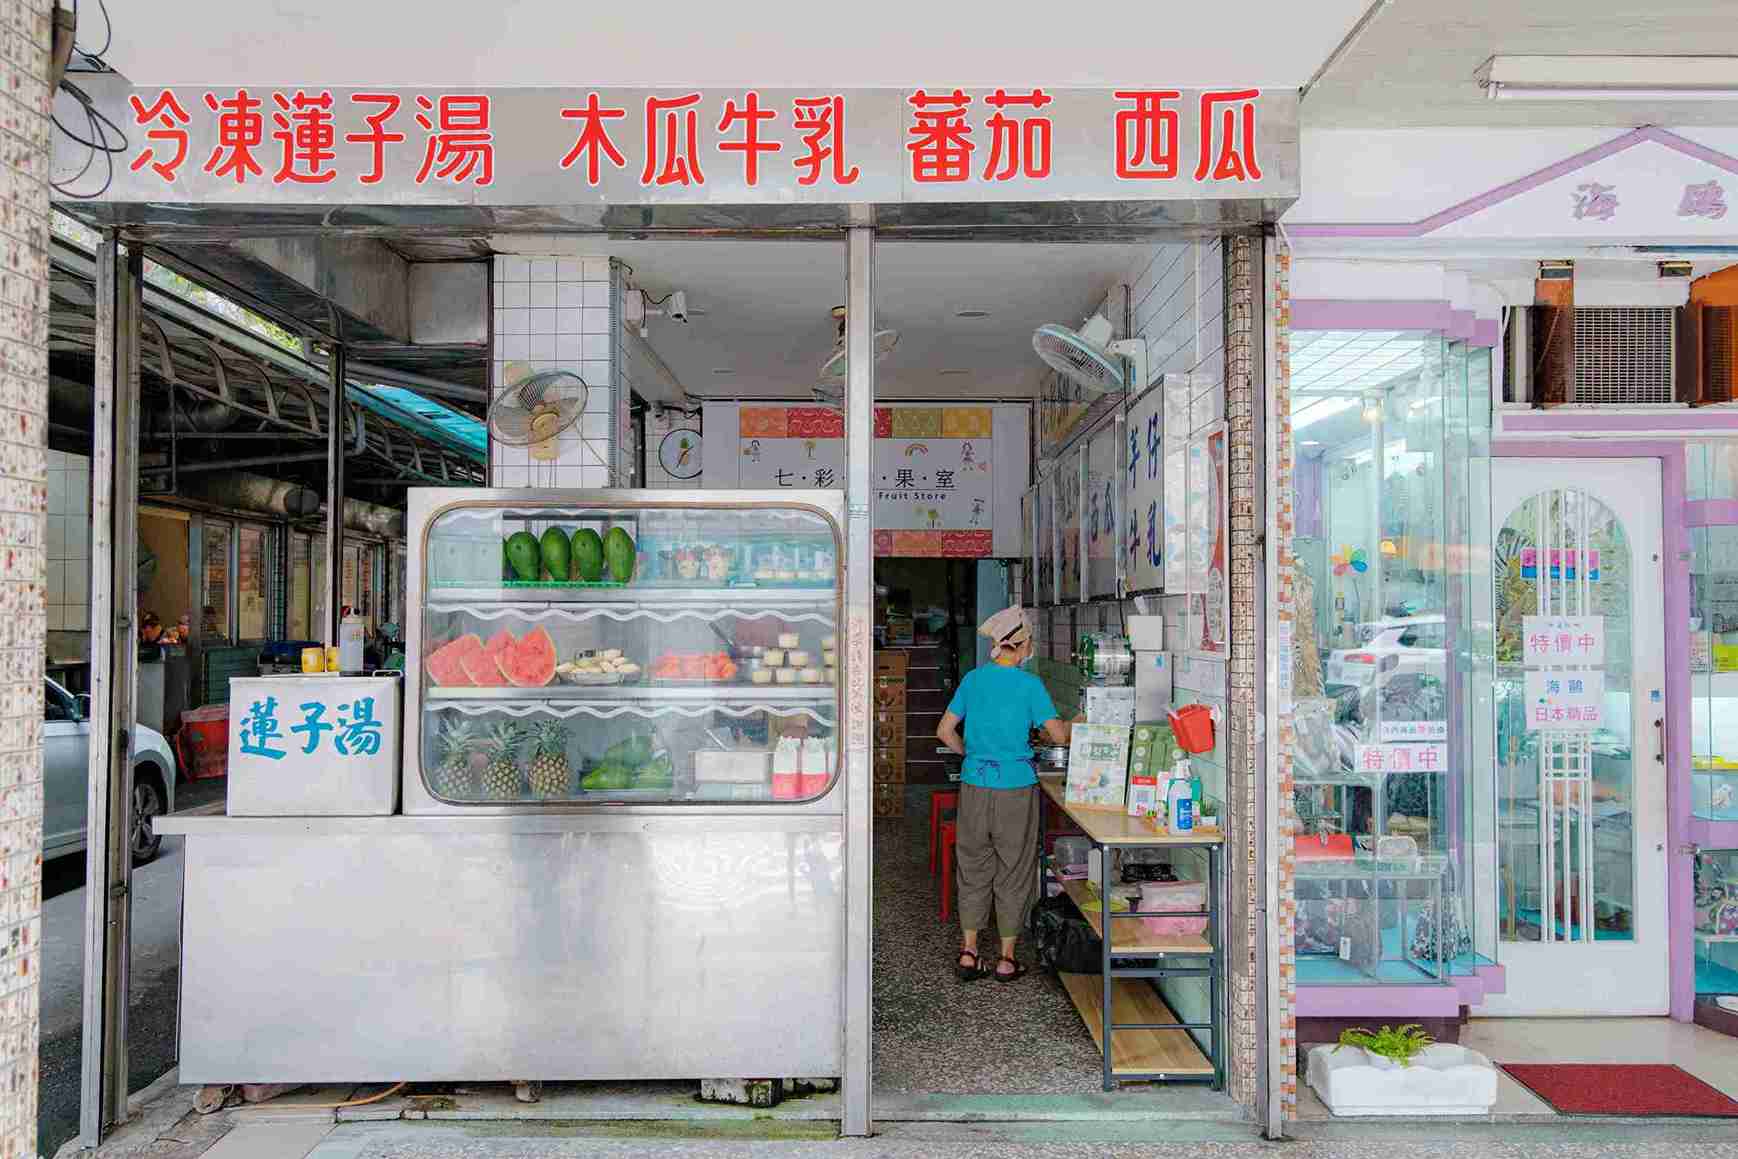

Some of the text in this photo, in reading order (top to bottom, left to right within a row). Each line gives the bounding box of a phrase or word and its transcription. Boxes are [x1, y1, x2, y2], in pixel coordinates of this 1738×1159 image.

[129, 88, 1262, 186] 冷凍蓮子湯 木瓜牛乳 蕃茄 西瓜
[878, 491, 948, 501] Fruit Store
[239, 696, 384, 761] 蓮子湯
